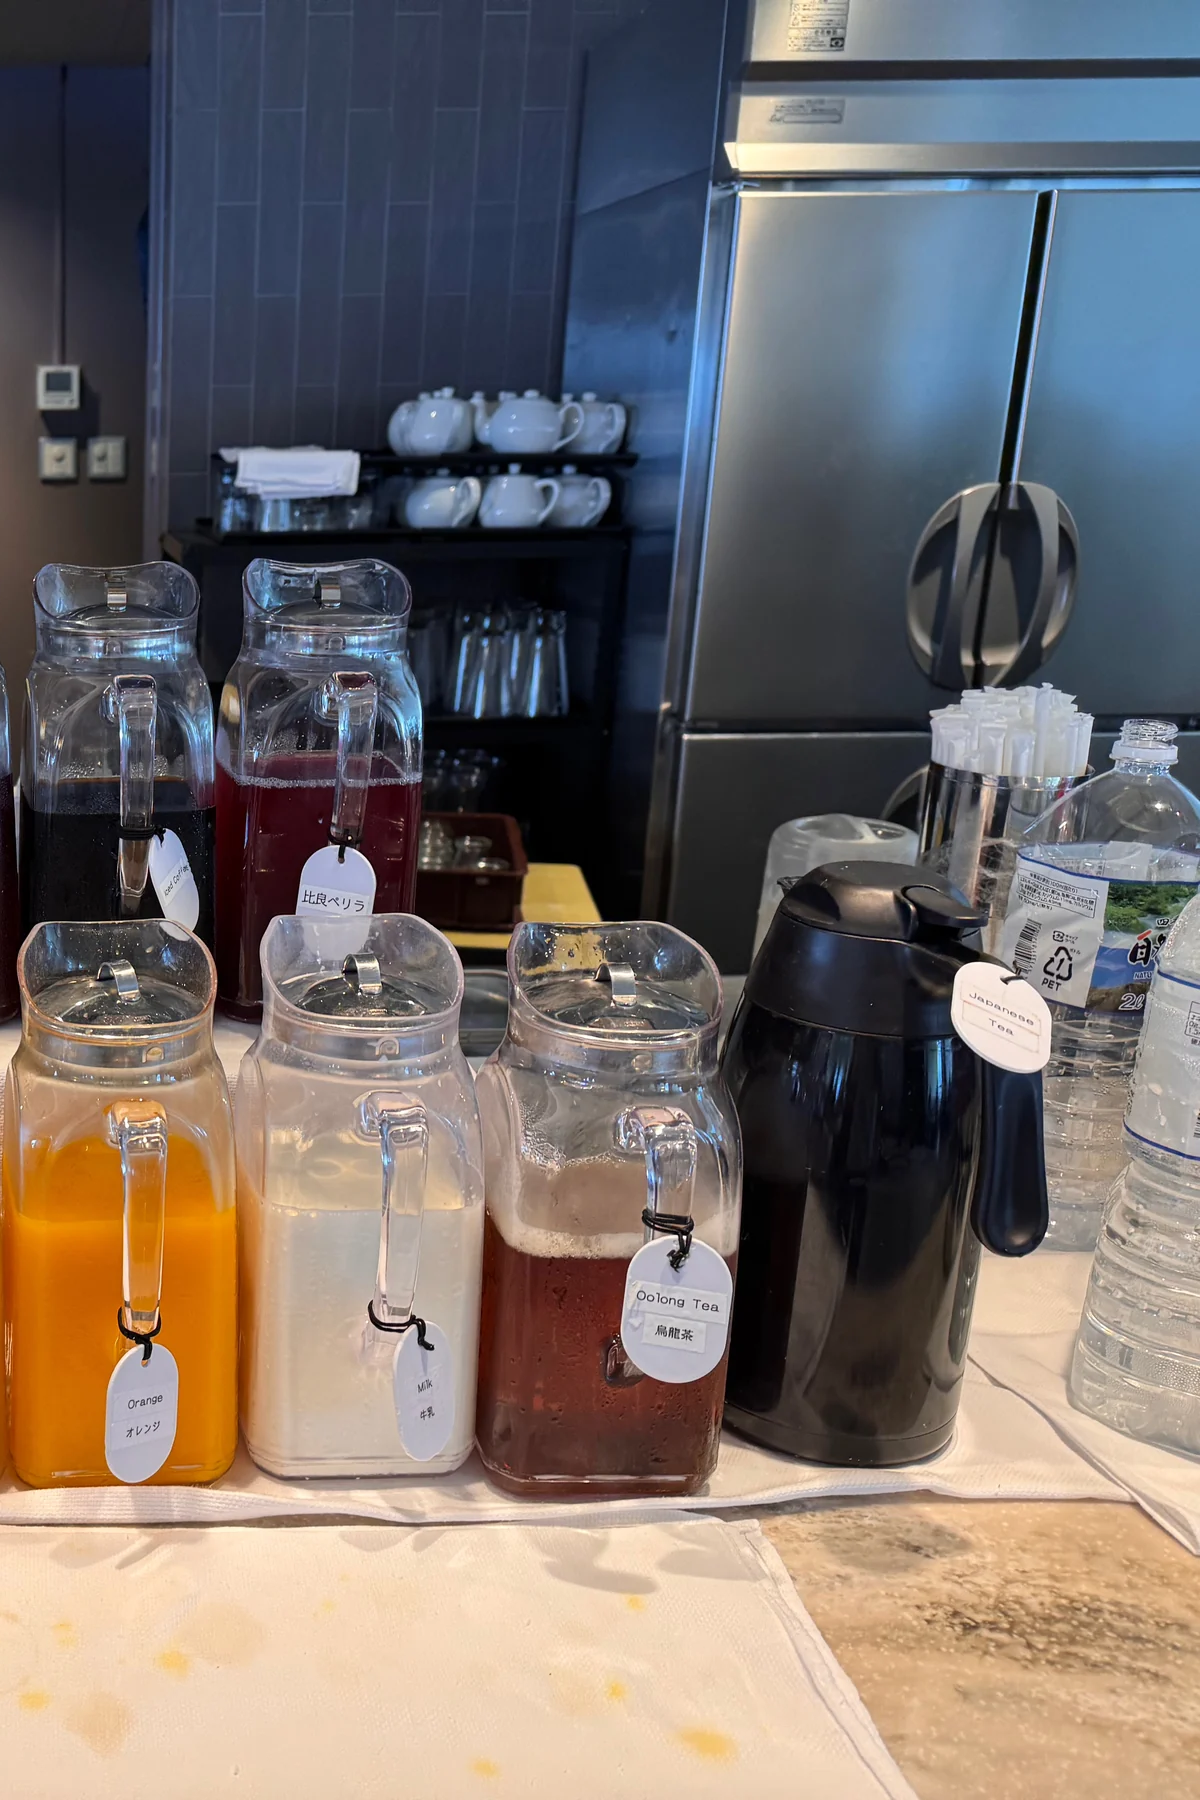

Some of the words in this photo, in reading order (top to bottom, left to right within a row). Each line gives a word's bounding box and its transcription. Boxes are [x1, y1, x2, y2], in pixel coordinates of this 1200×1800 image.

[301, 889, 365, 913] 比良ペリラ
[1041, 977, 1062, 992] PET
[968, 992, 1034, 1026] Japanese
[988, 1017, 1015, 1037] Tea
[636, 1290, 685, 1308] Oolong
[692, 1297, 720, 1313] Tea
[655, 1324, 694, 1342] 烏龍茶
[417, 1379, 433, 1394] Milk
[127, 1394, 164, 1410] Orange
[126, 1420, 161, 1438] オレンジ
